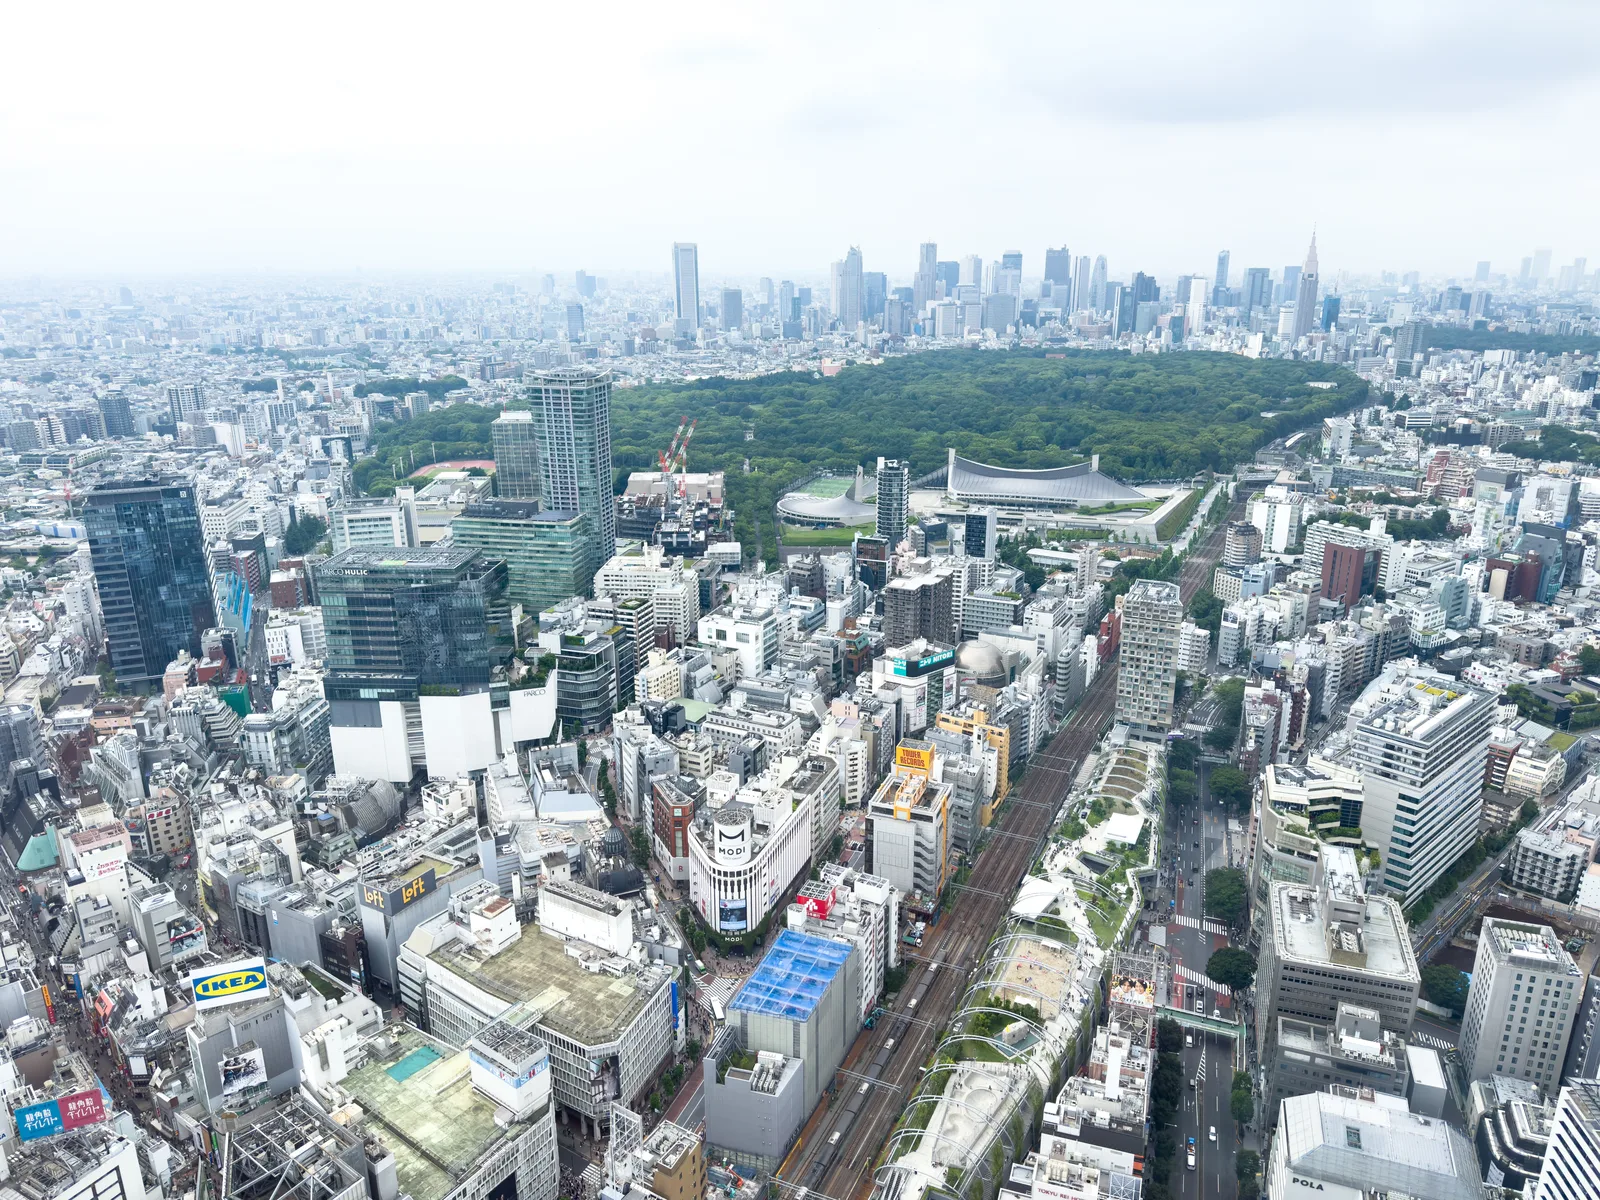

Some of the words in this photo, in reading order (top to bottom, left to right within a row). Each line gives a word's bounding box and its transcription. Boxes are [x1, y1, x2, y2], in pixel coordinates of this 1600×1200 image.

[933, 651, 953, 663] NITORI
[523, 688, 546, 697] PARCO
[902, 749, 921, 759] TOWER
[900, 756, 925, 767] RECORDS
[718, 846, 745, 856] MODI
[201, 974, 260, 993] IKEA
[1292, 1177, 1324, 1191] POLA
[1037, 1188, 1058, 1197] TOKYU
